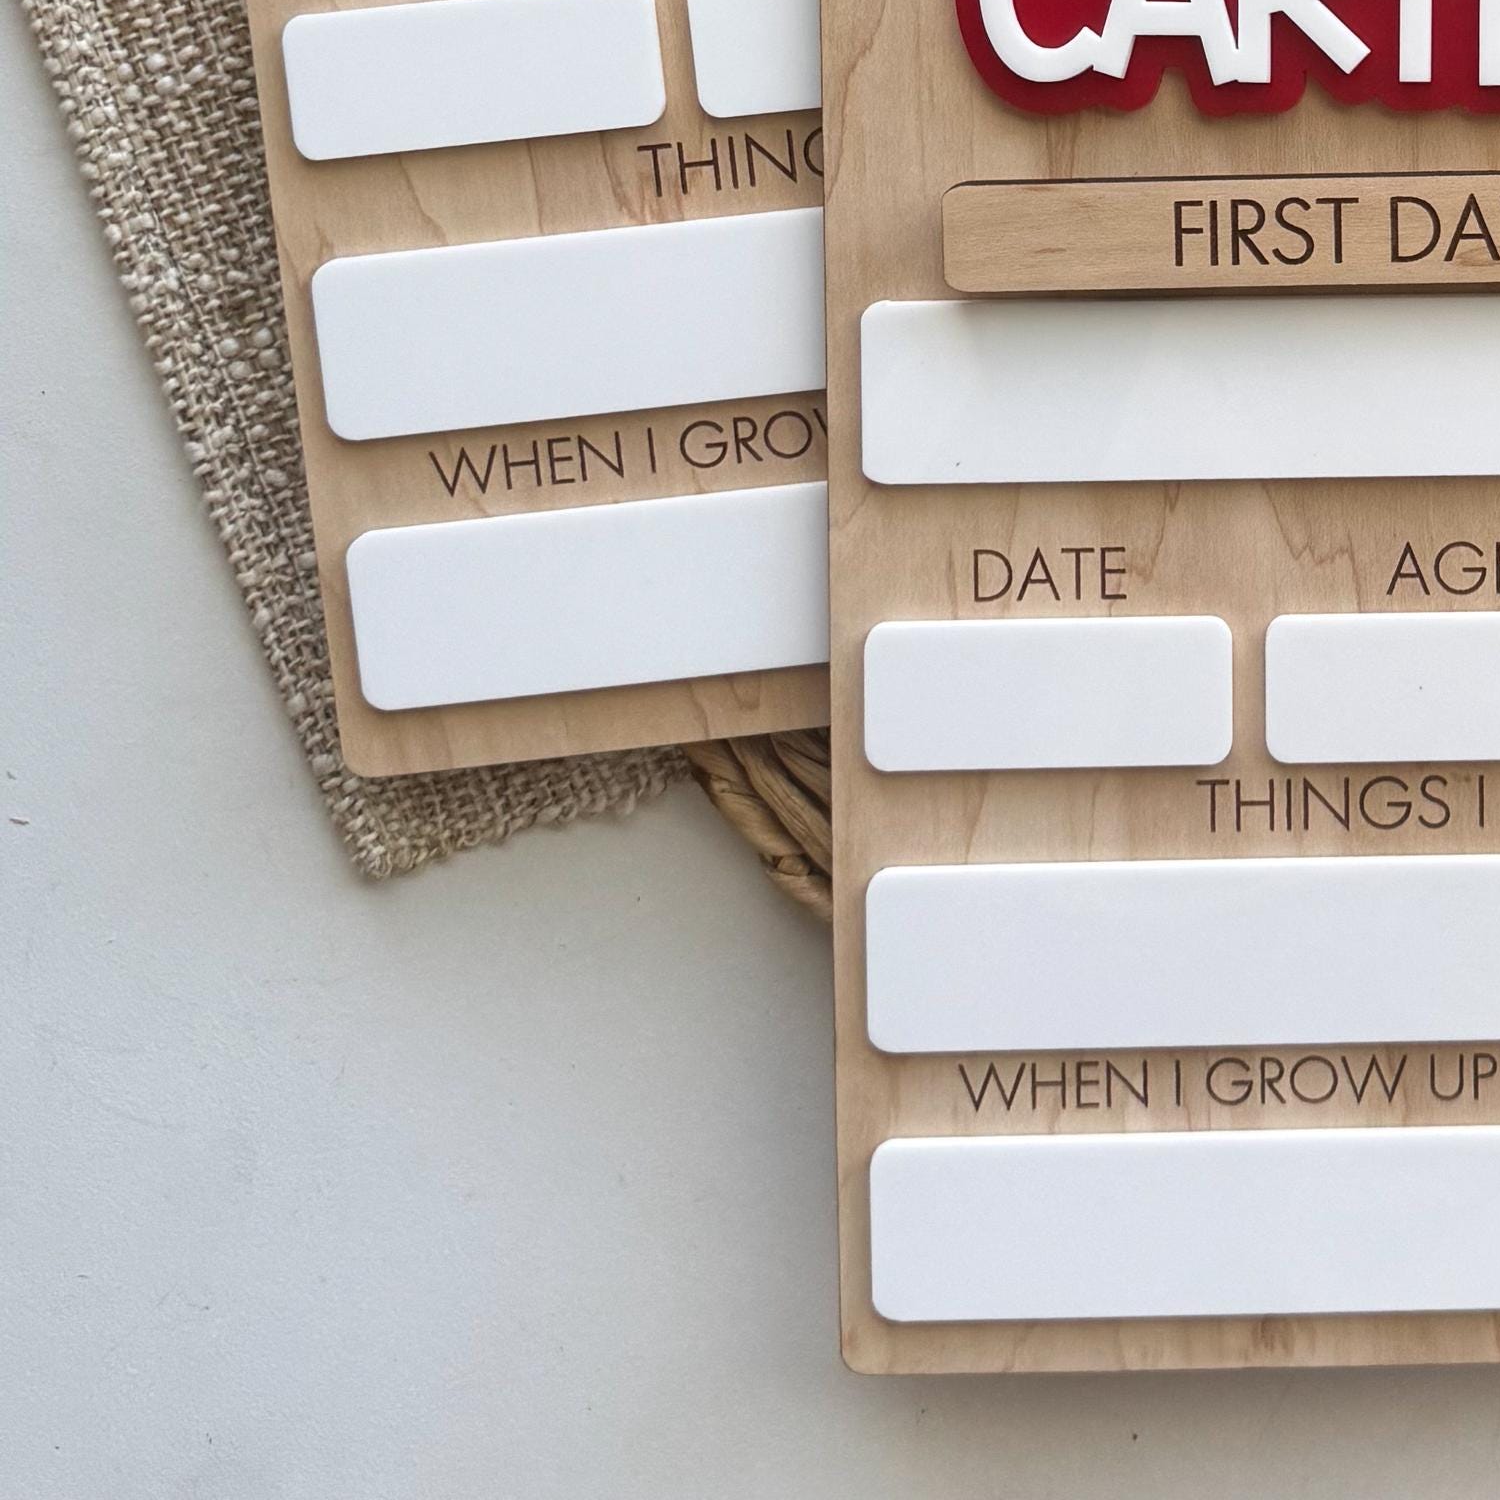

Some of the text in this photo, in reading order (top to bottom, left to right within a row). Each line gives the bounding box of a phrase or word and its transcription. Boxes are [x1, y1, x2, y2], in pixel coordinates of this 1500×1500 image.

[1173, 196, 1360, 267] FIRST
[429, 407, 828, 497] WHEN I GRO
[973, 546, 1127, 603] DATE
[1195, 774, 1451, 833] THINGS
[1478, 774, 1485, 828] I
[958, 1058, 1149, 1112] WHEN
[1174, 1058, 1181, 1106] I
[1205, 1053, 1408, 1106] GROW
[1430, 1052, 1498, 1101] UP
